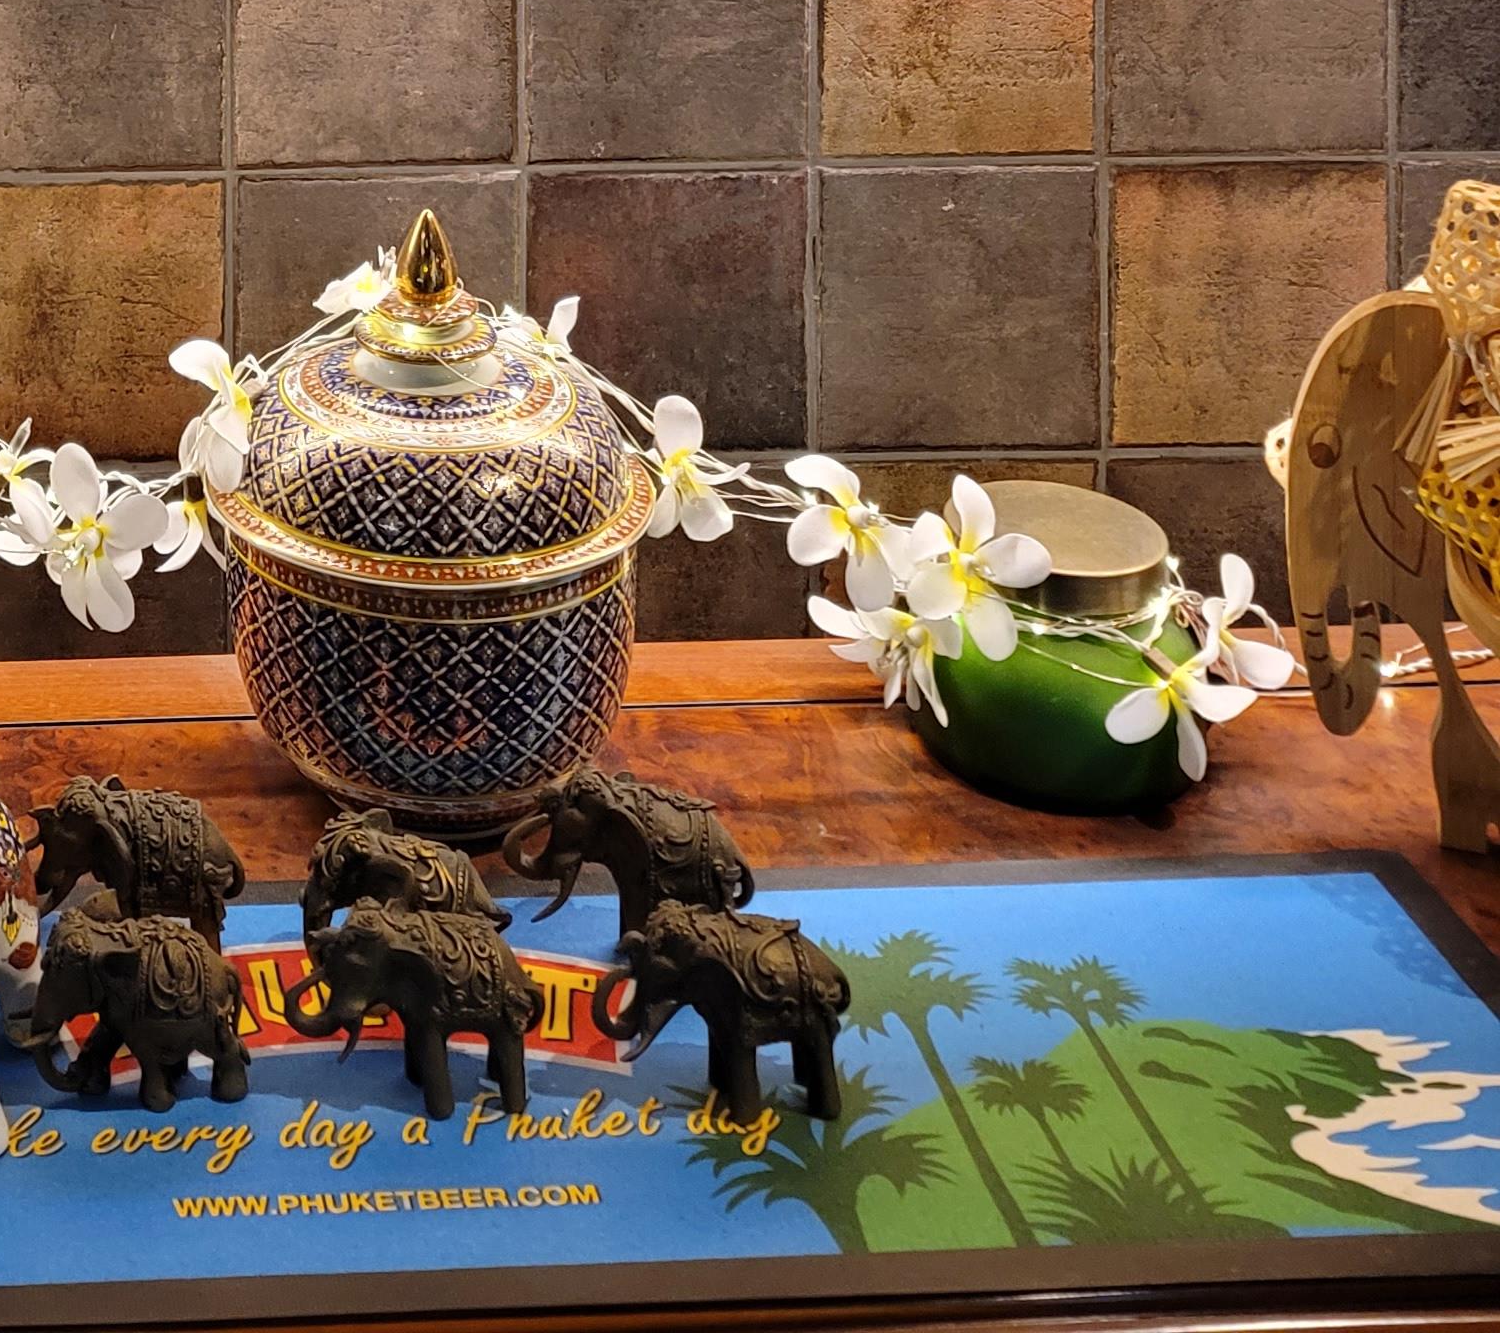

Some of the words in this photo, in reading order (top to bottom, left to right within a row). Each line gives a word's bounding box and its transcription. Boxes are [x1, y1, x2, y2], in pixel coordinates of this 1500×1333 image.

[90, 1121, 255, 1174] every
[280, 1100, 374, 1171] day
[401, 1116, 430, 1145] a
[172, 1184, 600, 1218] WWW.PHUKETBEER.COM
